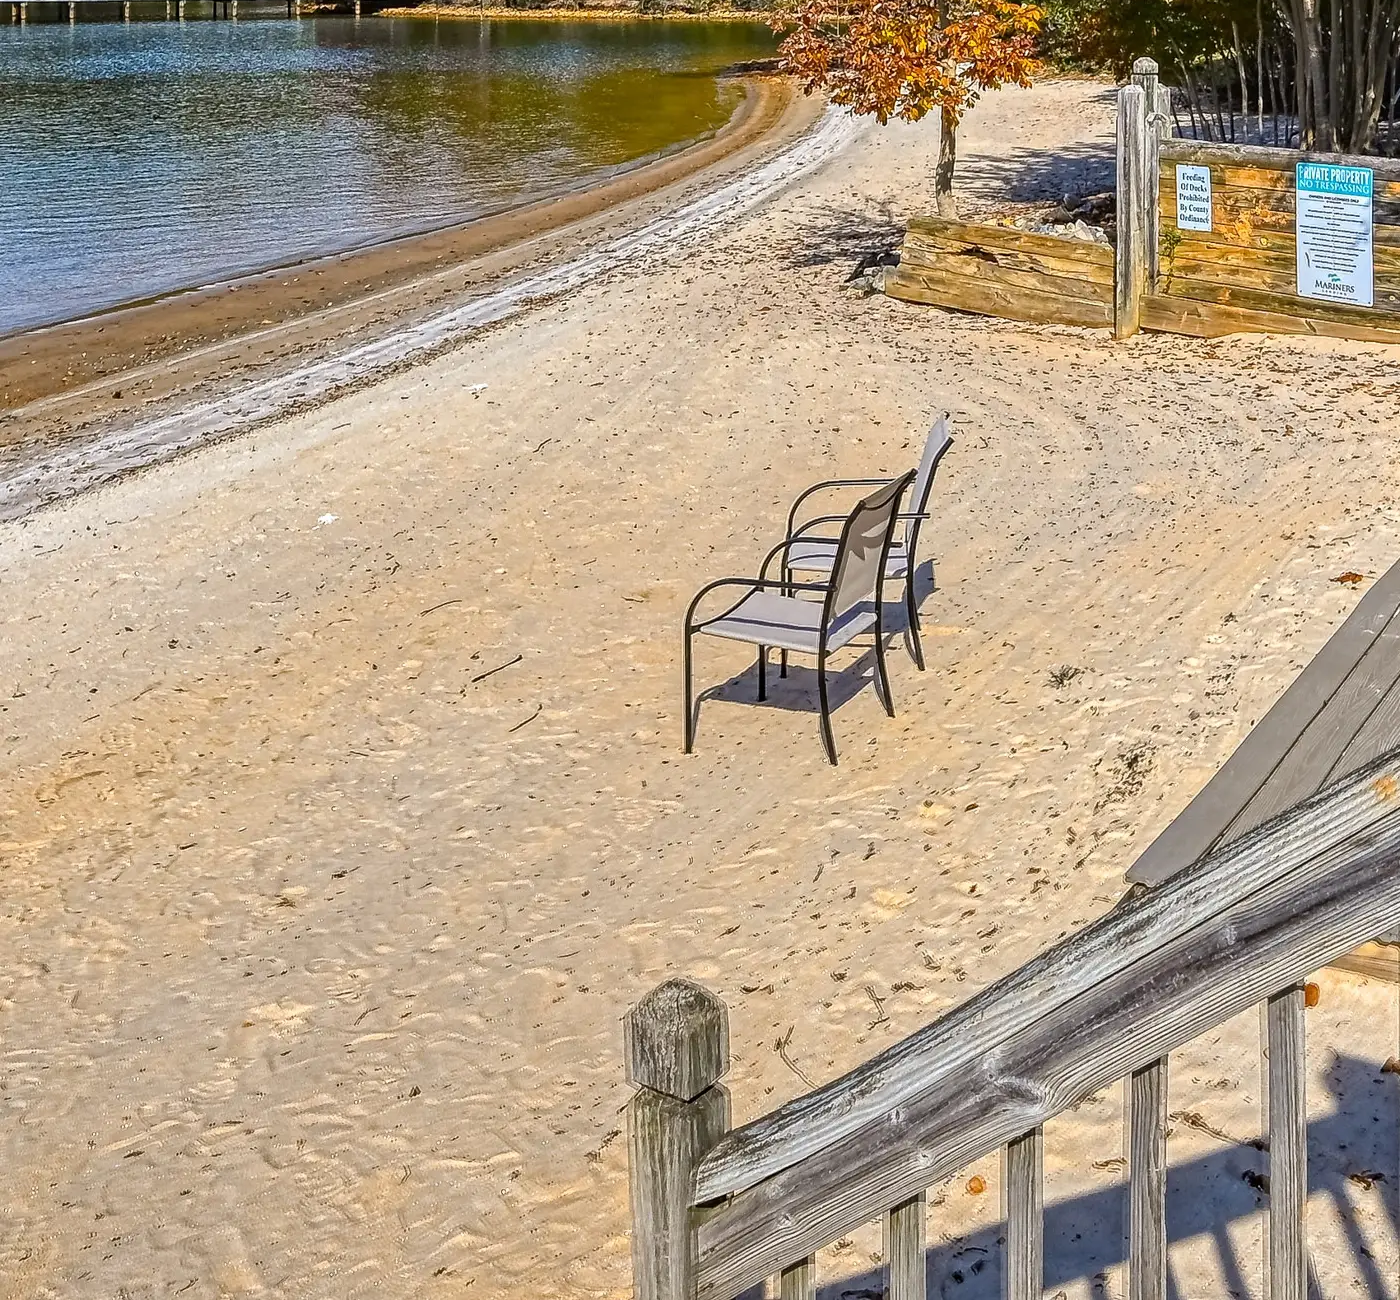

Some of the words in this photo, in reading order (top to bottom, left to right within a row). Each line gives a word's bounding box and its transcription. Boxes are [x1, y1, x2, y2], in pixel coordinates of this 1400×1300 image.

[1182, 172, 1205, 183] Feeding
[1299, 165, 1329, 181] PRIVATE
[1331, 168, 1370, 186] PROPERTY
[1180, 182, 1189, 191] Of
[1299, 179, 1313, 188] NO
[1315, 180, 1370, 194] TRESPASSING
[1179, 192, 1210, 203] Prohibited
[1180, 203, 1188, 213] By
[1189, 204, 1209, 215] County
[1179, 213, 1210, 224] Ordinance
[1314, 279, 1355, 294] MARINERS
